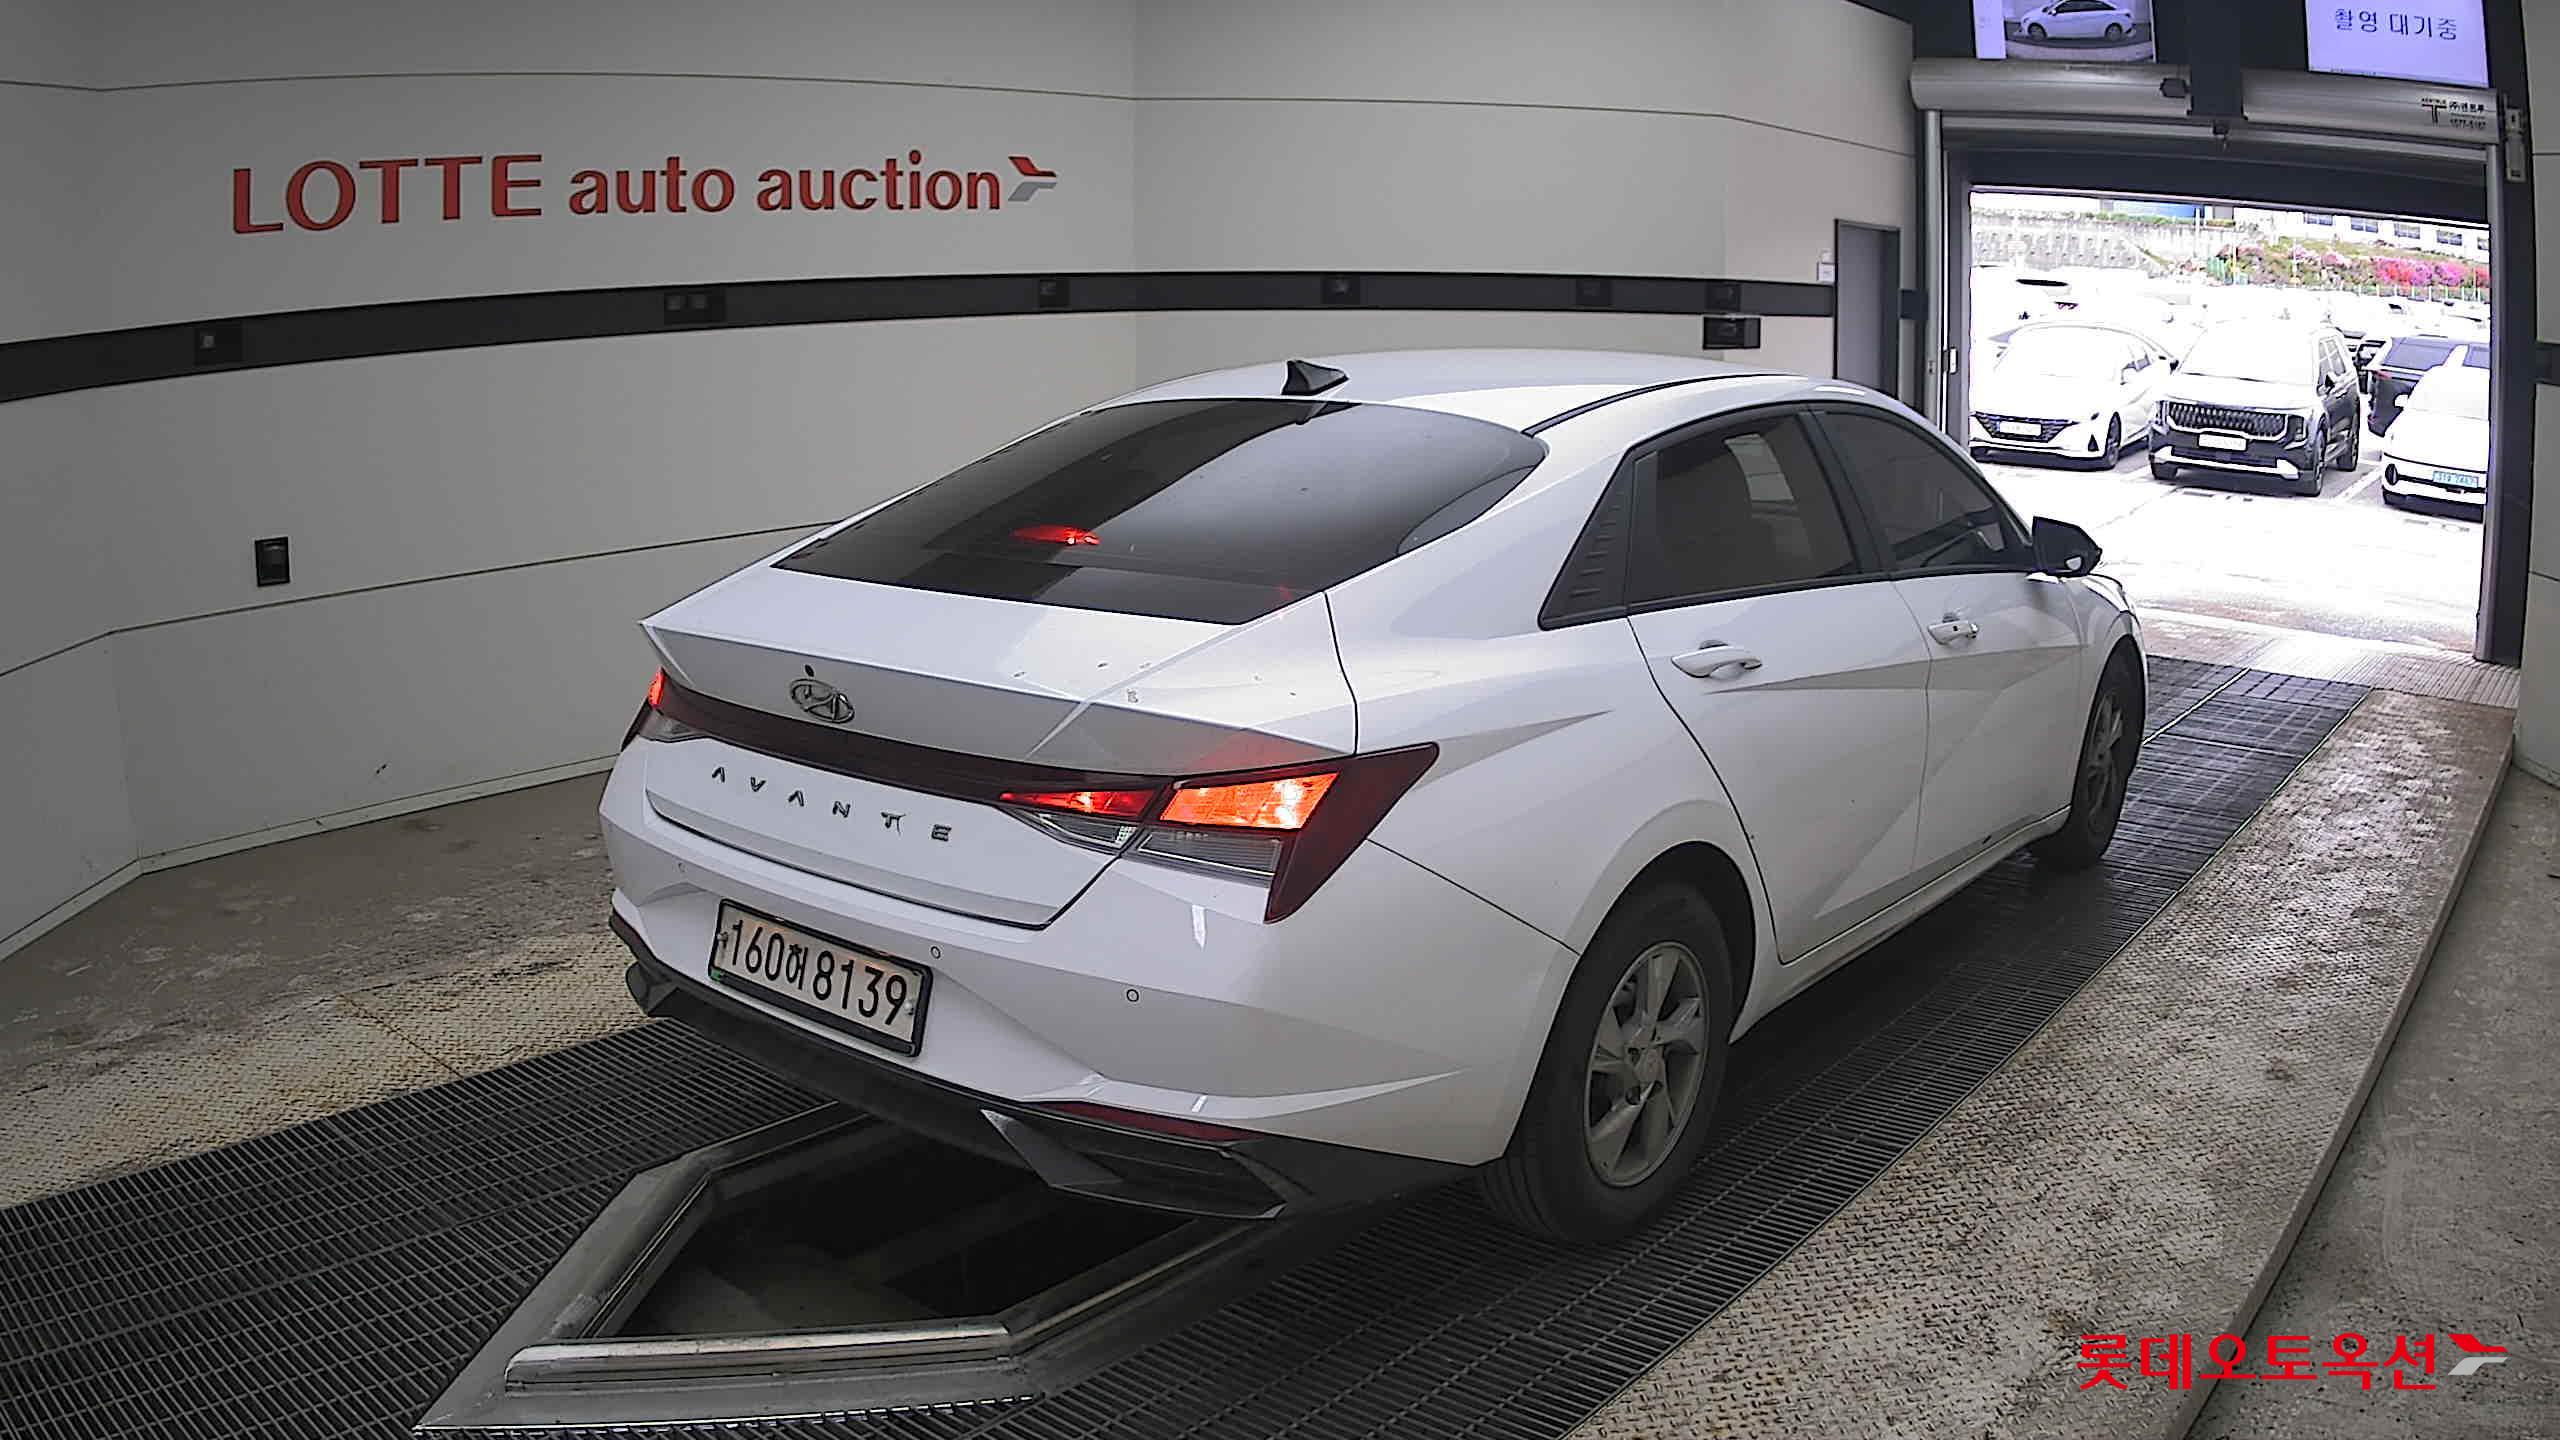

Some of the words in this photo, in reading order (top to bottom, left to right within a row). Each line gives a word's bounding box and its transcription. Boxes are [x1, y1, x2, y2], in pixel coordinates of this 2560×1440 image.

[2335, 8, 2378, 33] 촬영
[2389, 13, 2457, 41] 대기중
[232, 154, 542, 234] LOTTE
[569, 156, 735, 214] auto
[757, 149, 1001, 211] auction
[711, 766, 952, 842] AVANTE
[732, 919, 908, 1026] 160허8139
